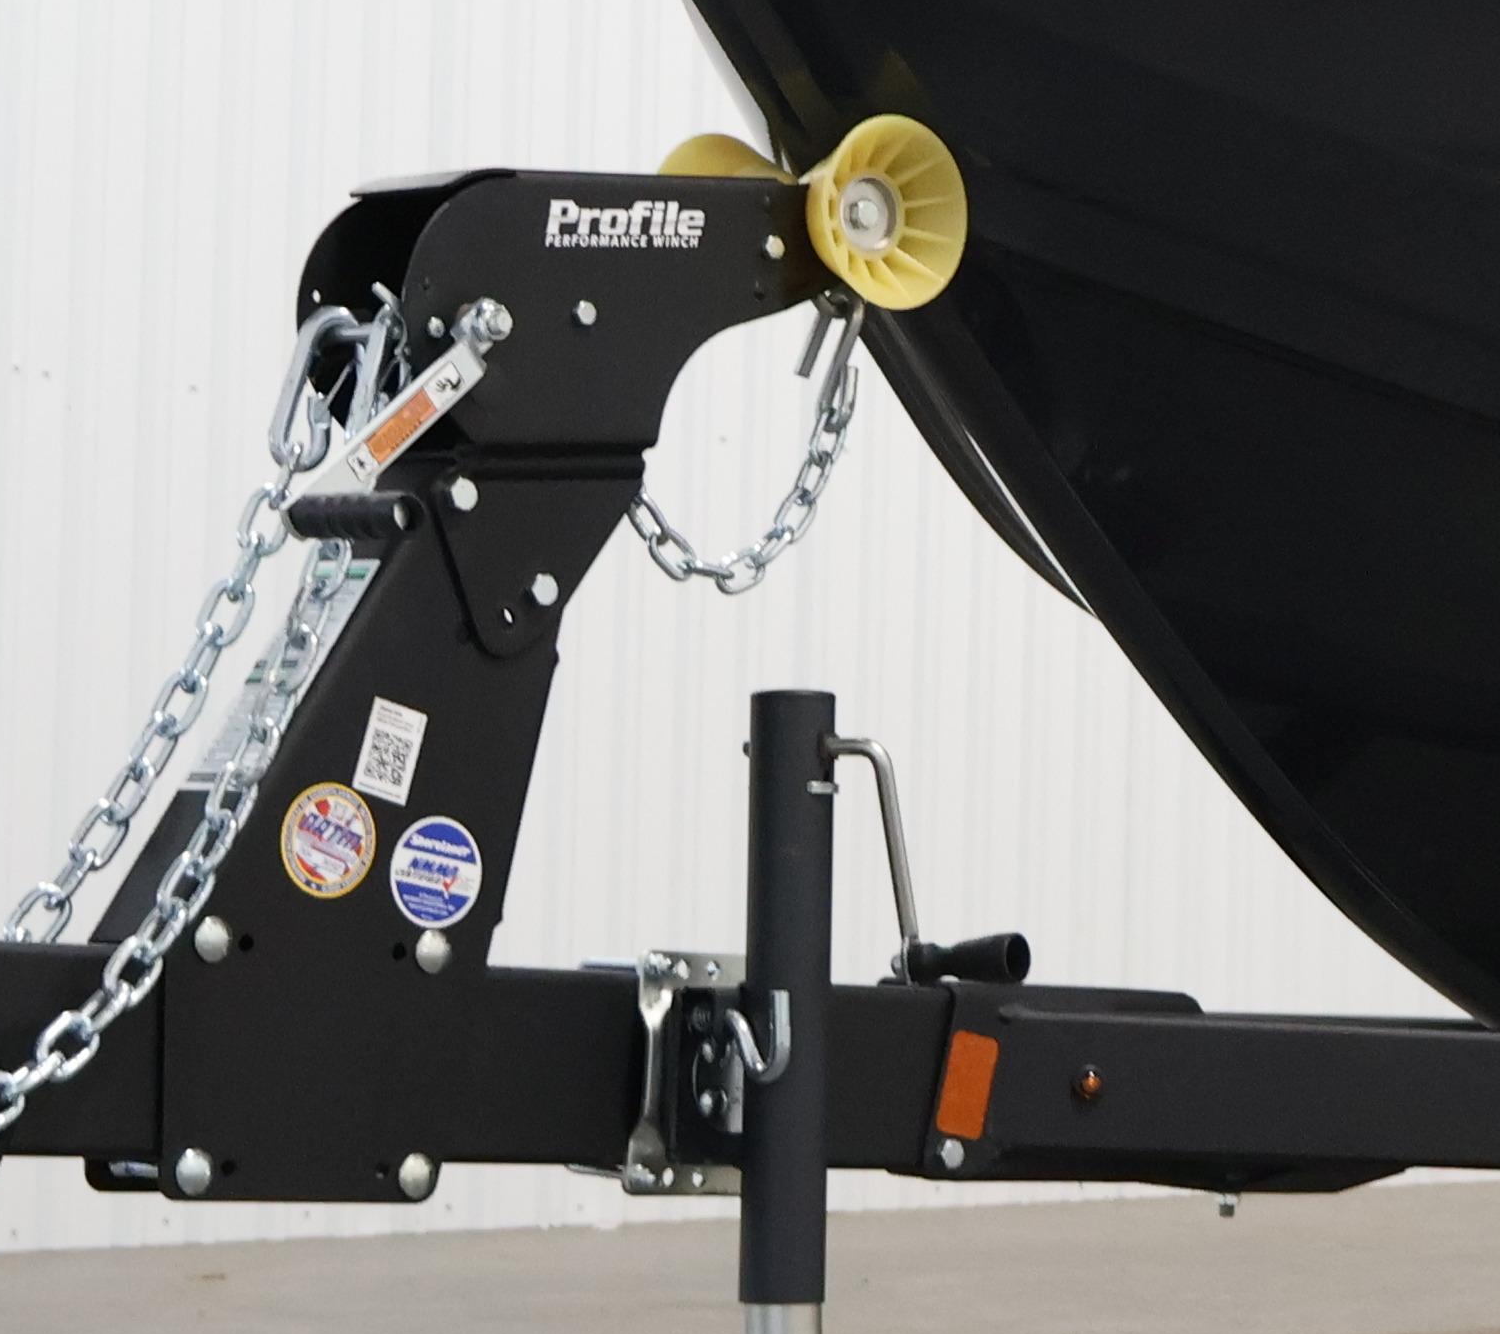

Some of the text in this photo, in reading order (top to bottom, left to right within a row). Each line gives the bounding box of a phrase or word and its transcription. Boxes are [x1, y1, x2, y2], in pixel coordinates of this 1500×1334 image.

[545, 199, 706, 236] Profile
[545, 234, 699, 249] PERFORMANCE WINCH
